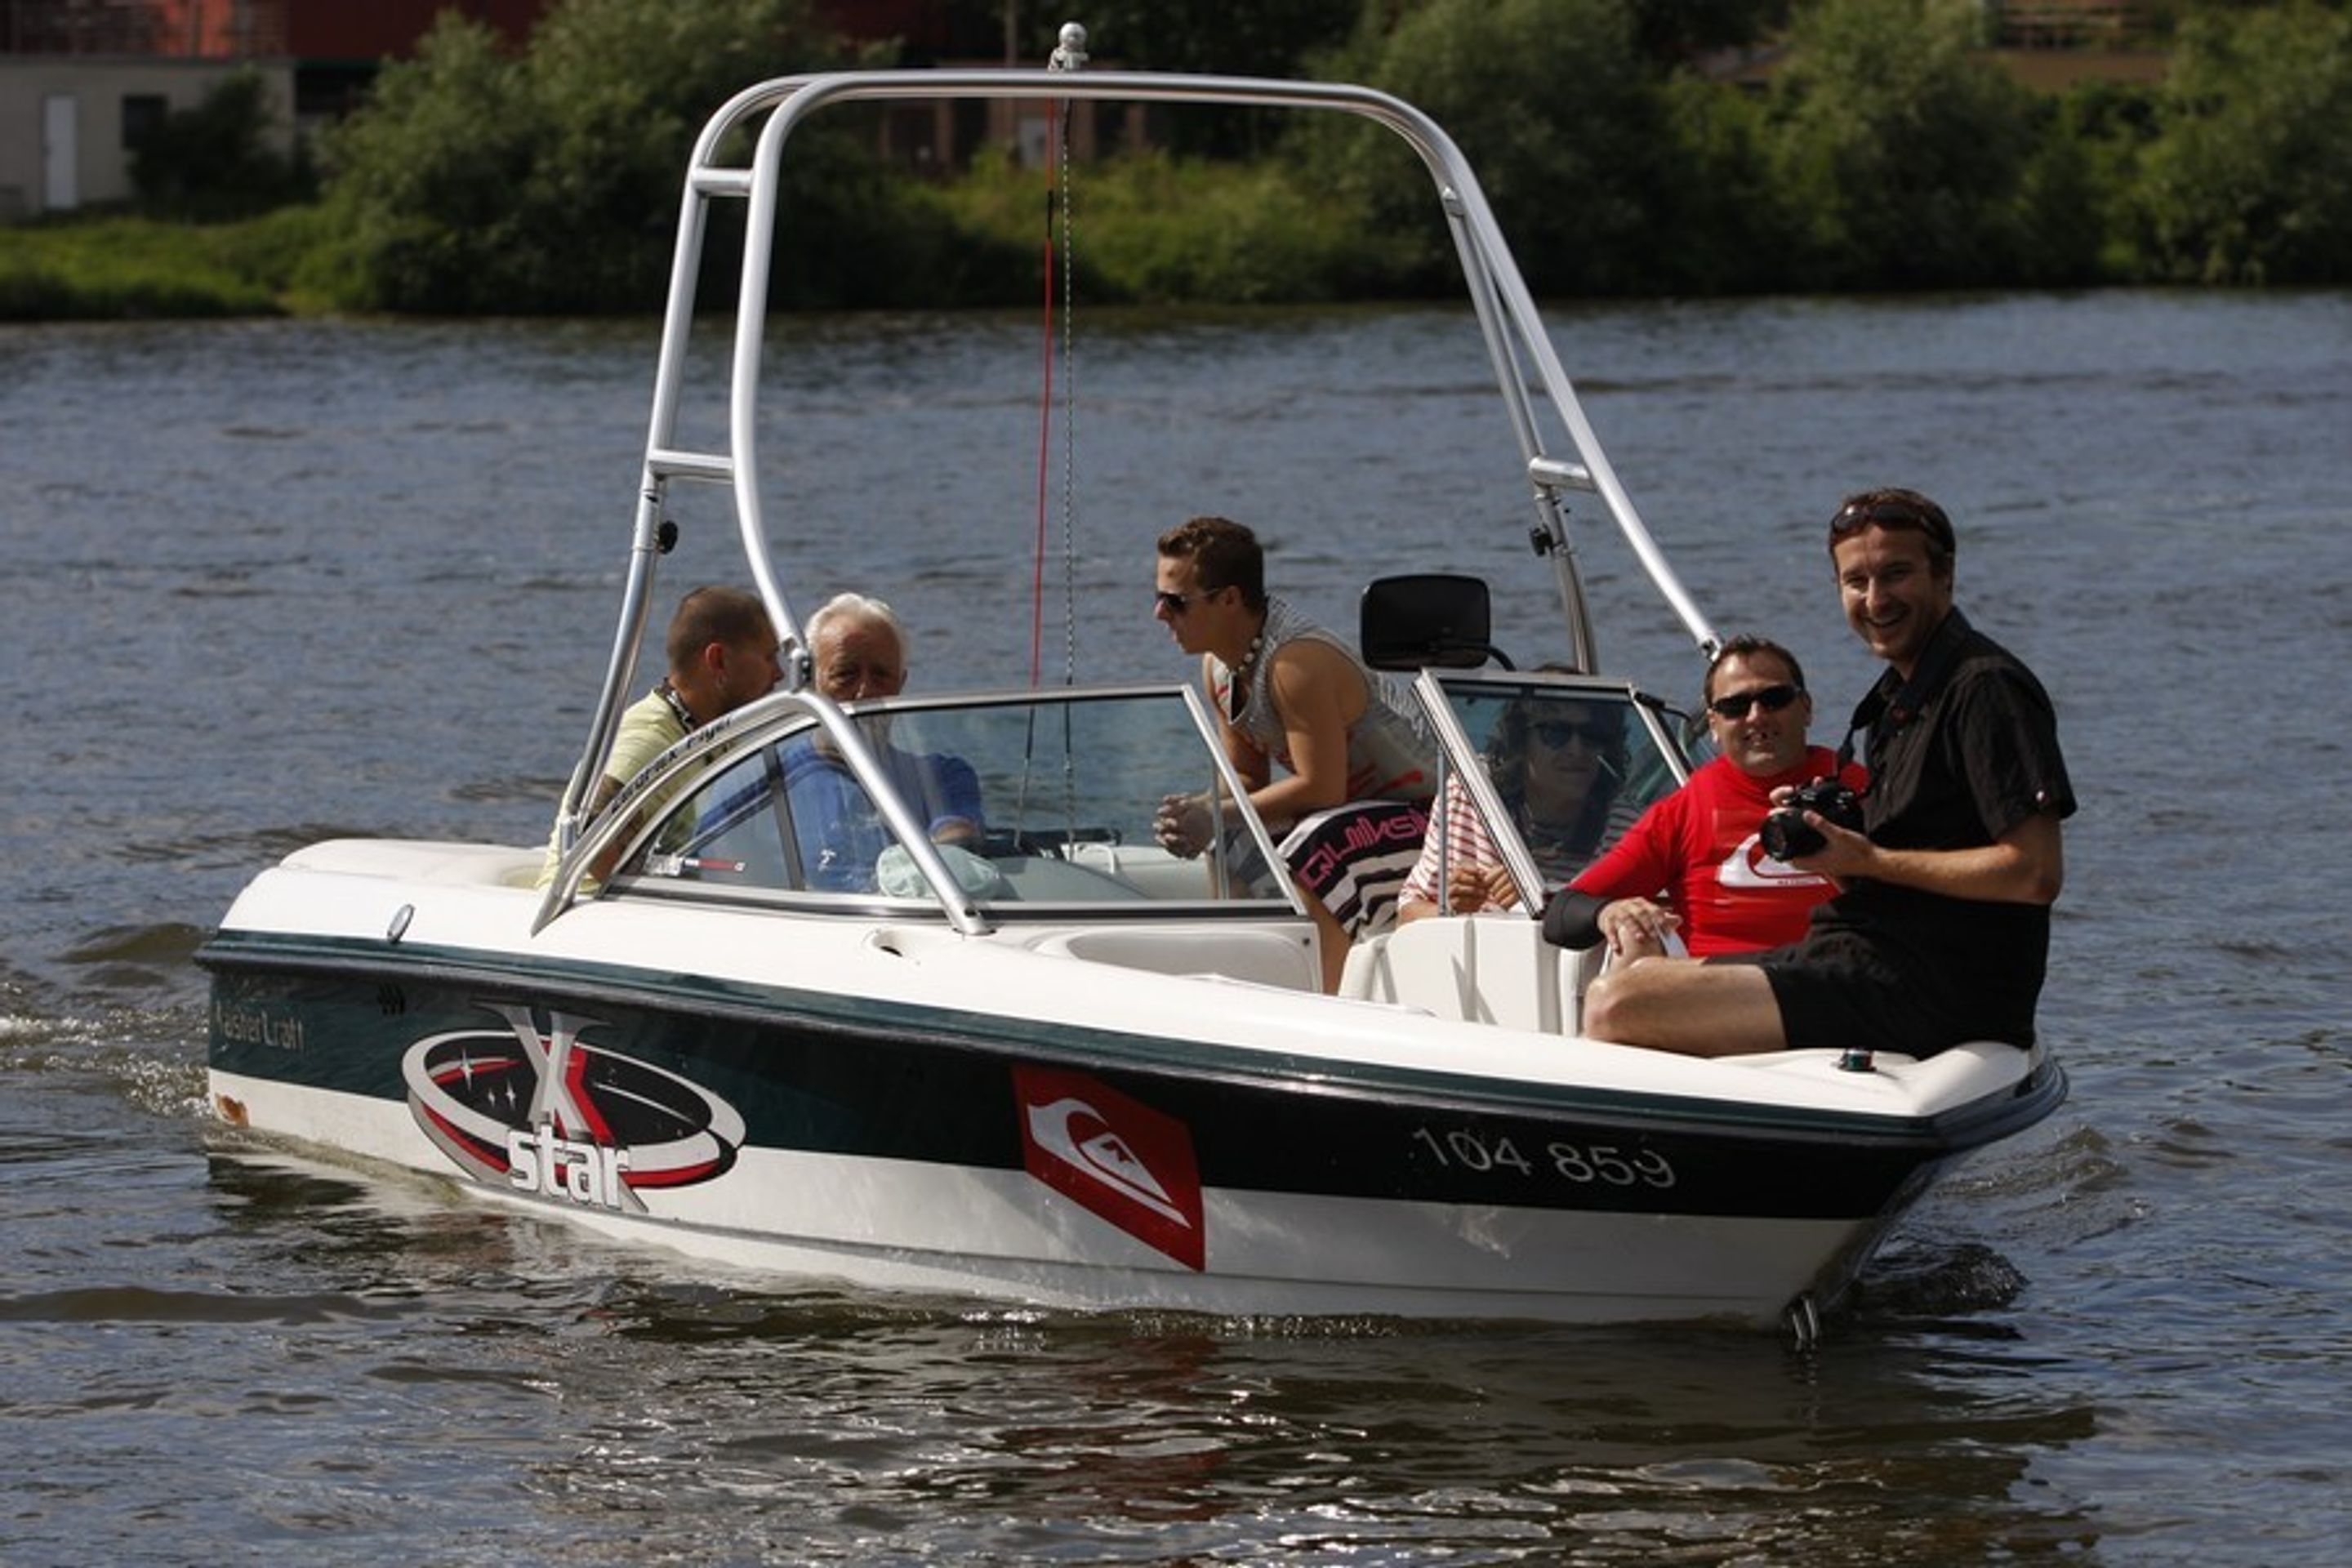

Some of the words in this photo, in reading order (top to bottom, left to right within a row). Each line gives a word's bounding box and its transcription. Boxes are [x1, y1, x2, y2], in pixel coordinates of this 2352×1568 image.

[509, 1124, 630, 1210] star
[1413, 1128, 1530, 1175] 104
[1548, 1143, 1675, 1187] 859
